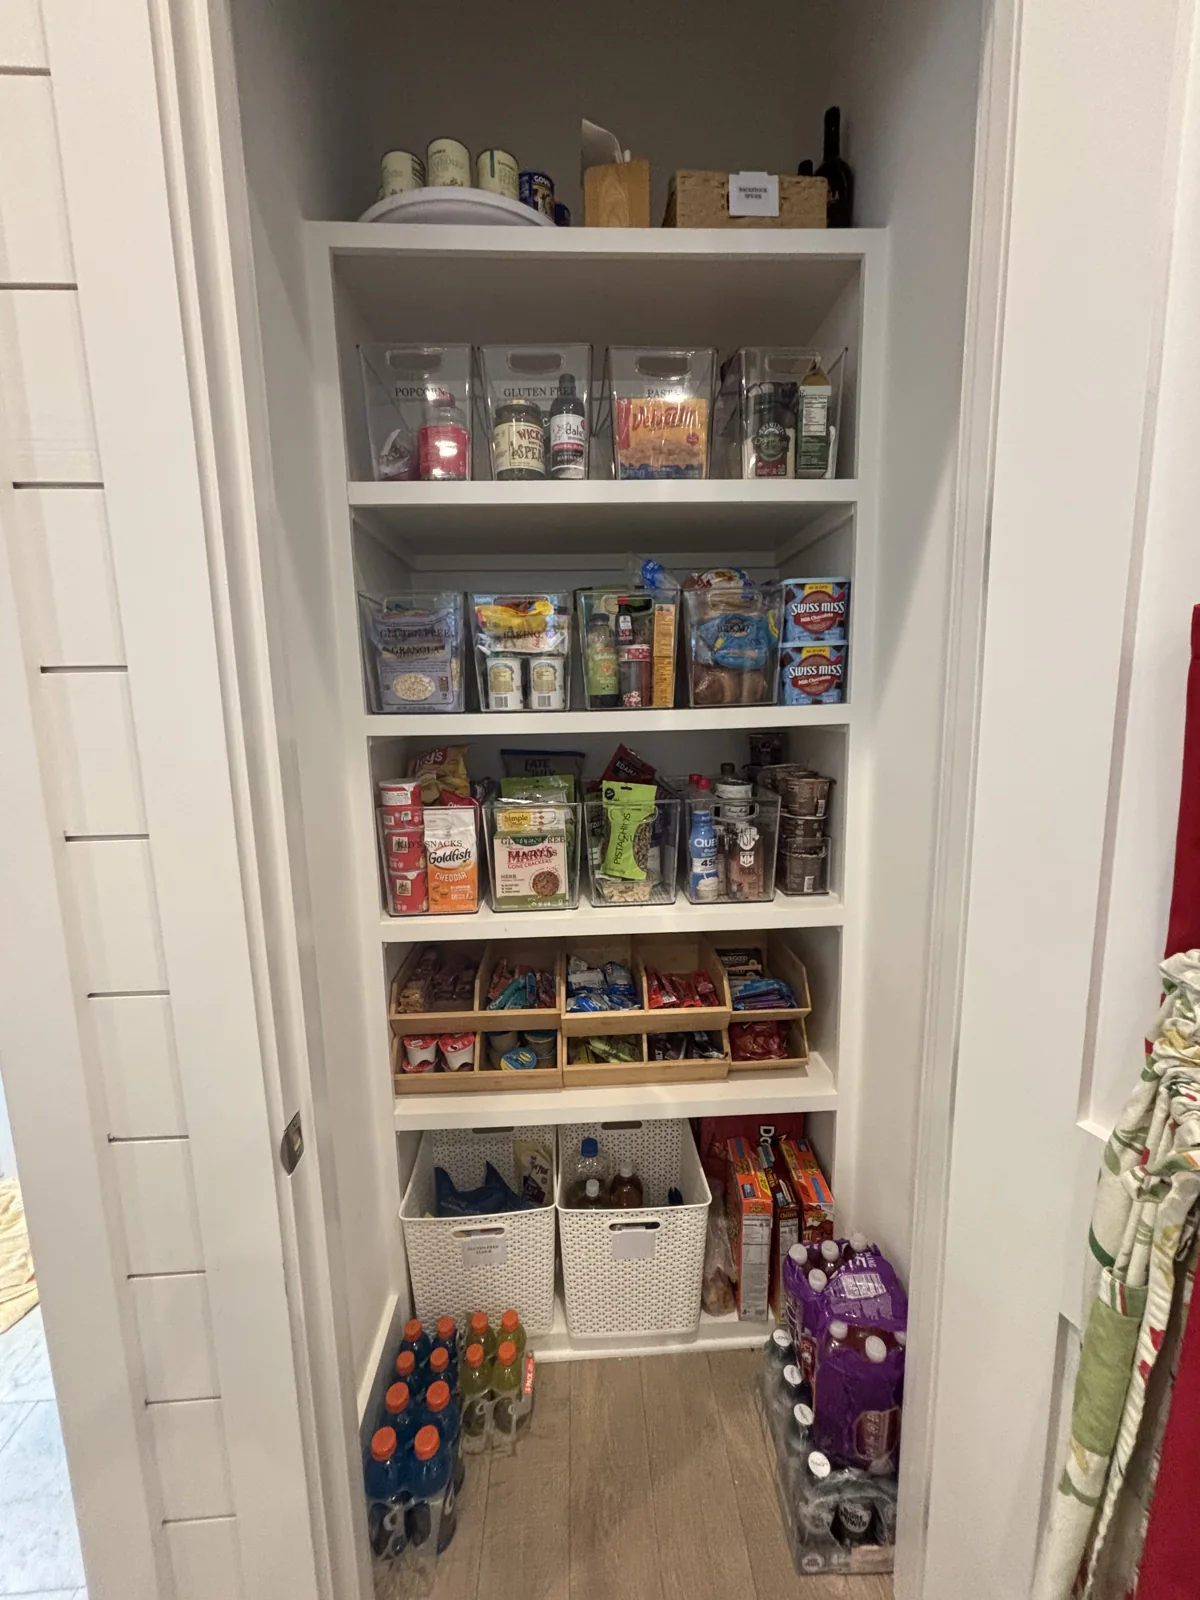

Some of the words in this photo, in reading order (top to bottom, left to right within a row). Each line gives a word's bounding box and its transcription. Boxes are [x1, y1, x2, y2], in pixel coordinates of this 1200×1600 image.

[503, 387, 546, 398] GLUTEN
[791, 602, 819, 615] SWISS
[789, 666, 817, 679] SWISS
[428, 848, 472, 865] Goldfish
[434, 871, 468, 882] CHEDDAR
